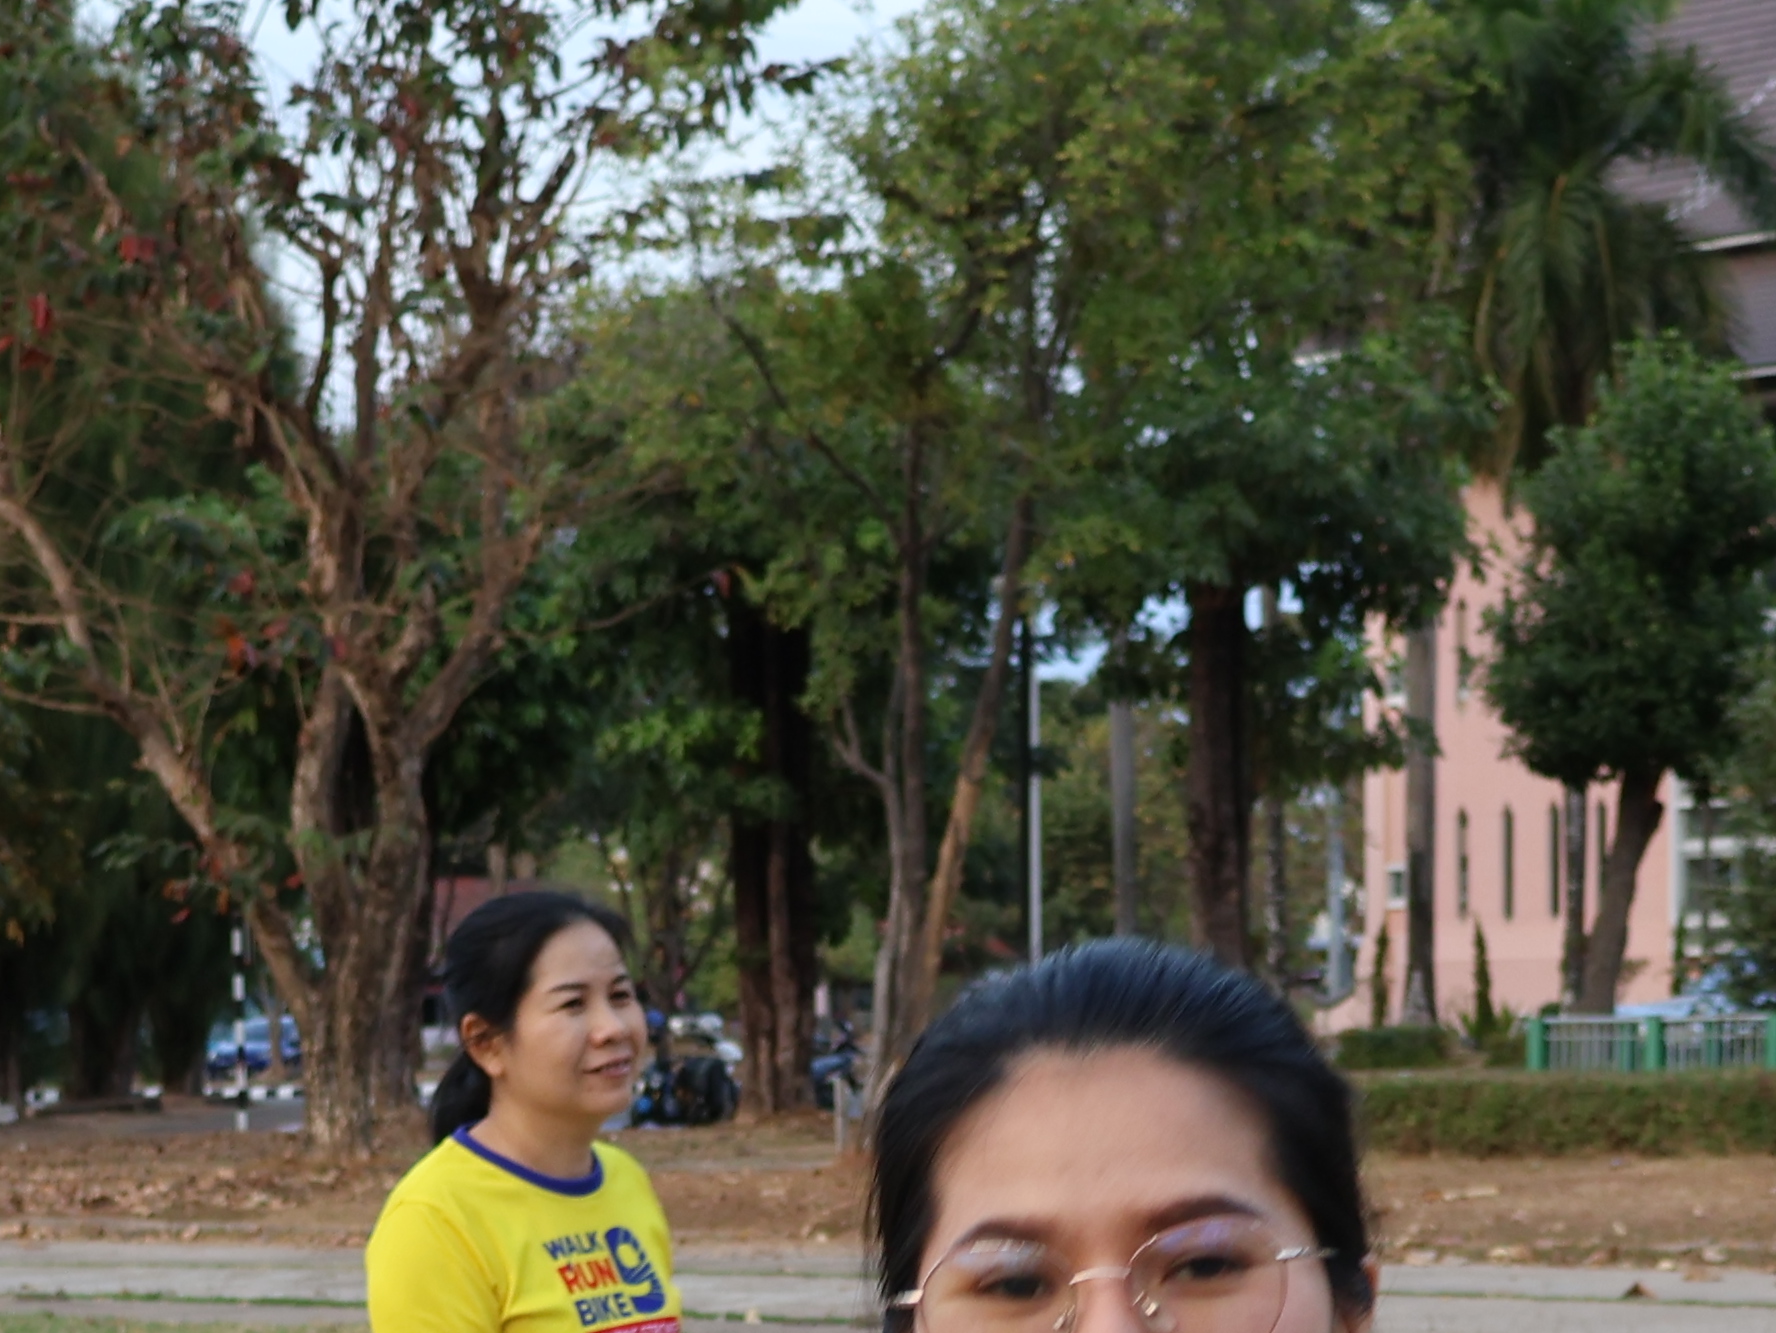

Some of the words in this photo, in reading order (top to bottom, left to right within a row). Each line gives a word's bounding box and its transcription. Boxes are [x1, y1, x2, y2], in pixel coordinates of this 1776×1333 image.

[543, 1231, 604, 1260] WALK
[558, 1257, 618, 1295] RUN
[575, 1292, 631, 1326] BIKE
